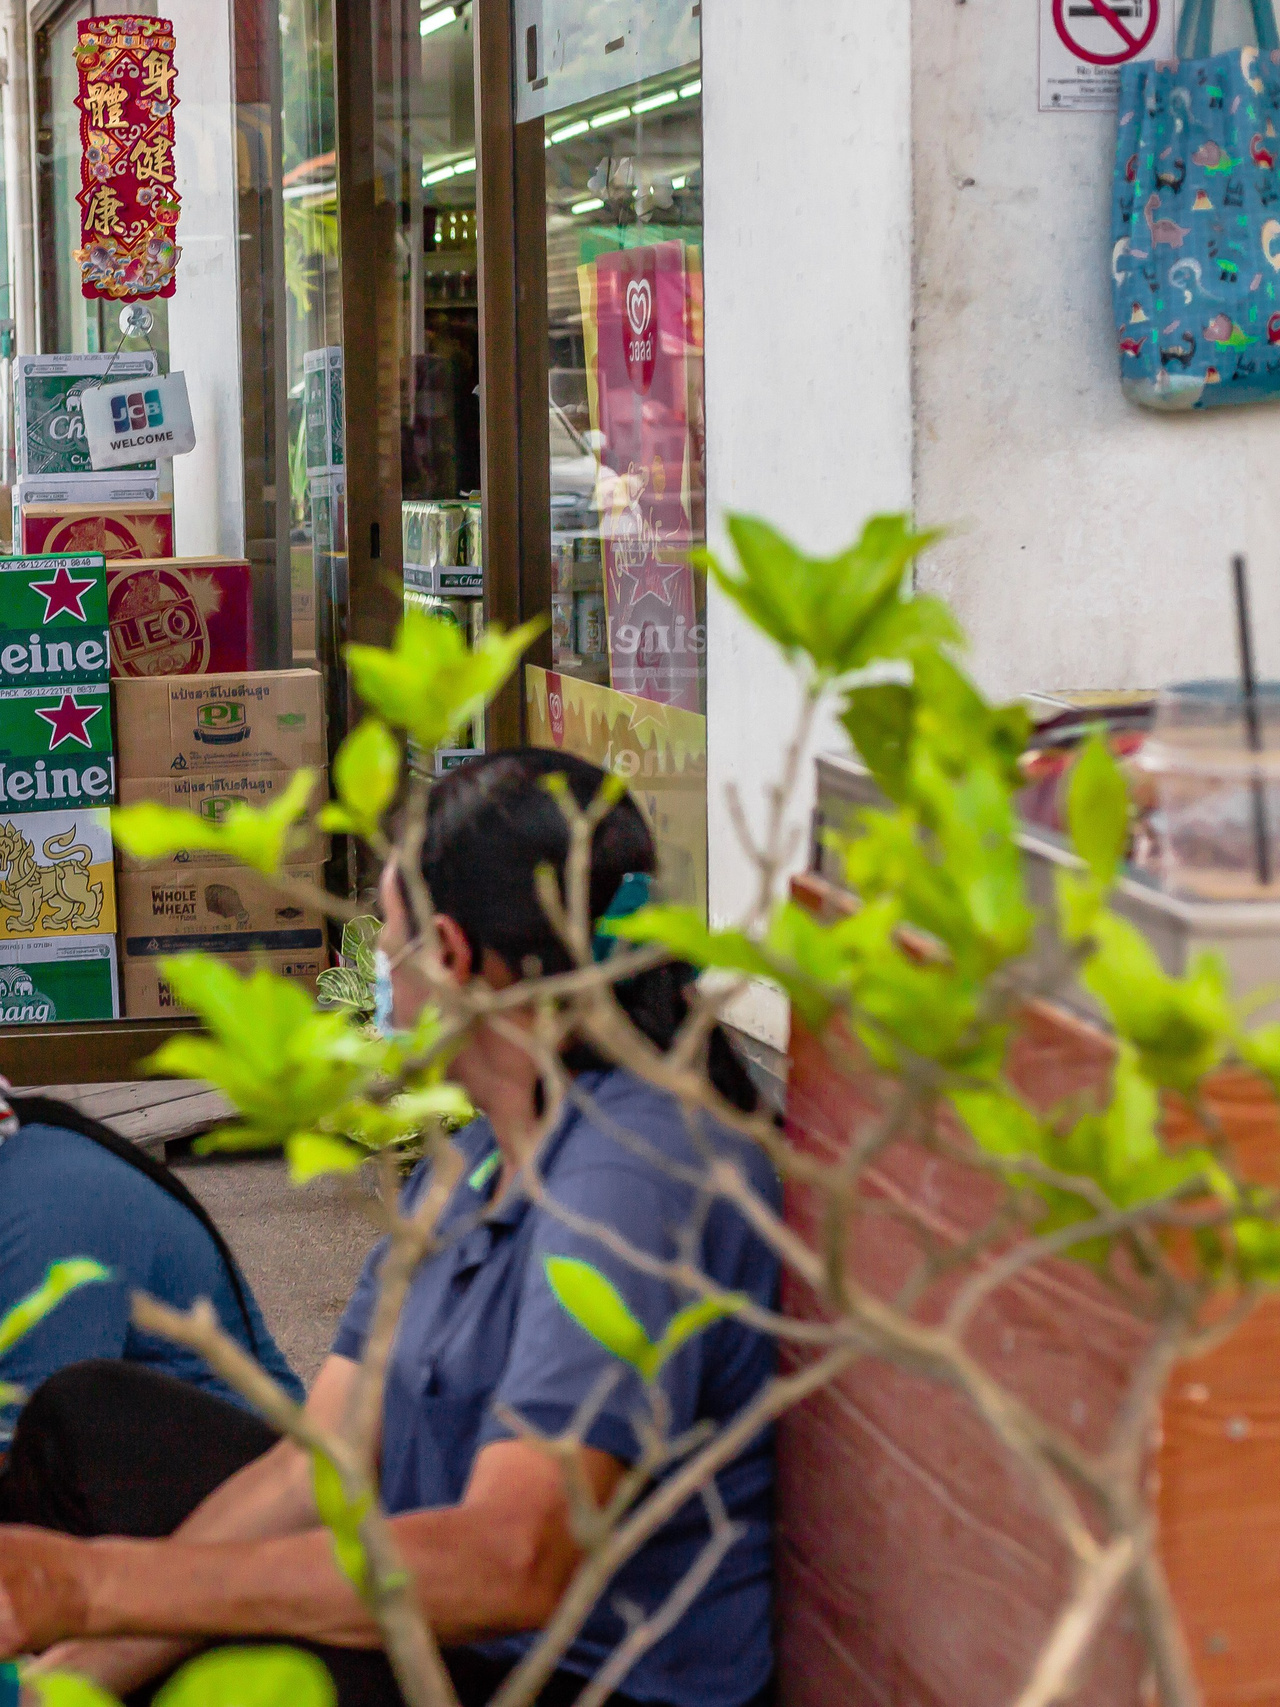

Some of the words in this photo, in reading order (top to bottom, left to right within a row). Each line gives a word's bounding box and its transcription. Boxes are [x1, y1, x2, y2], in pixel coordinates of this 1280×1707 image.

[111, 399, 163, 424] JCB
[110, 431, 174, 450] WELCOME
[111, 604, 197, 660] LEO
[0, 690, 19, 698] PACK
[200, 702, 243, 726] PI
[151, 890, 197, 902] WHOLE
[152, 903, 196, 915] WHEAT
